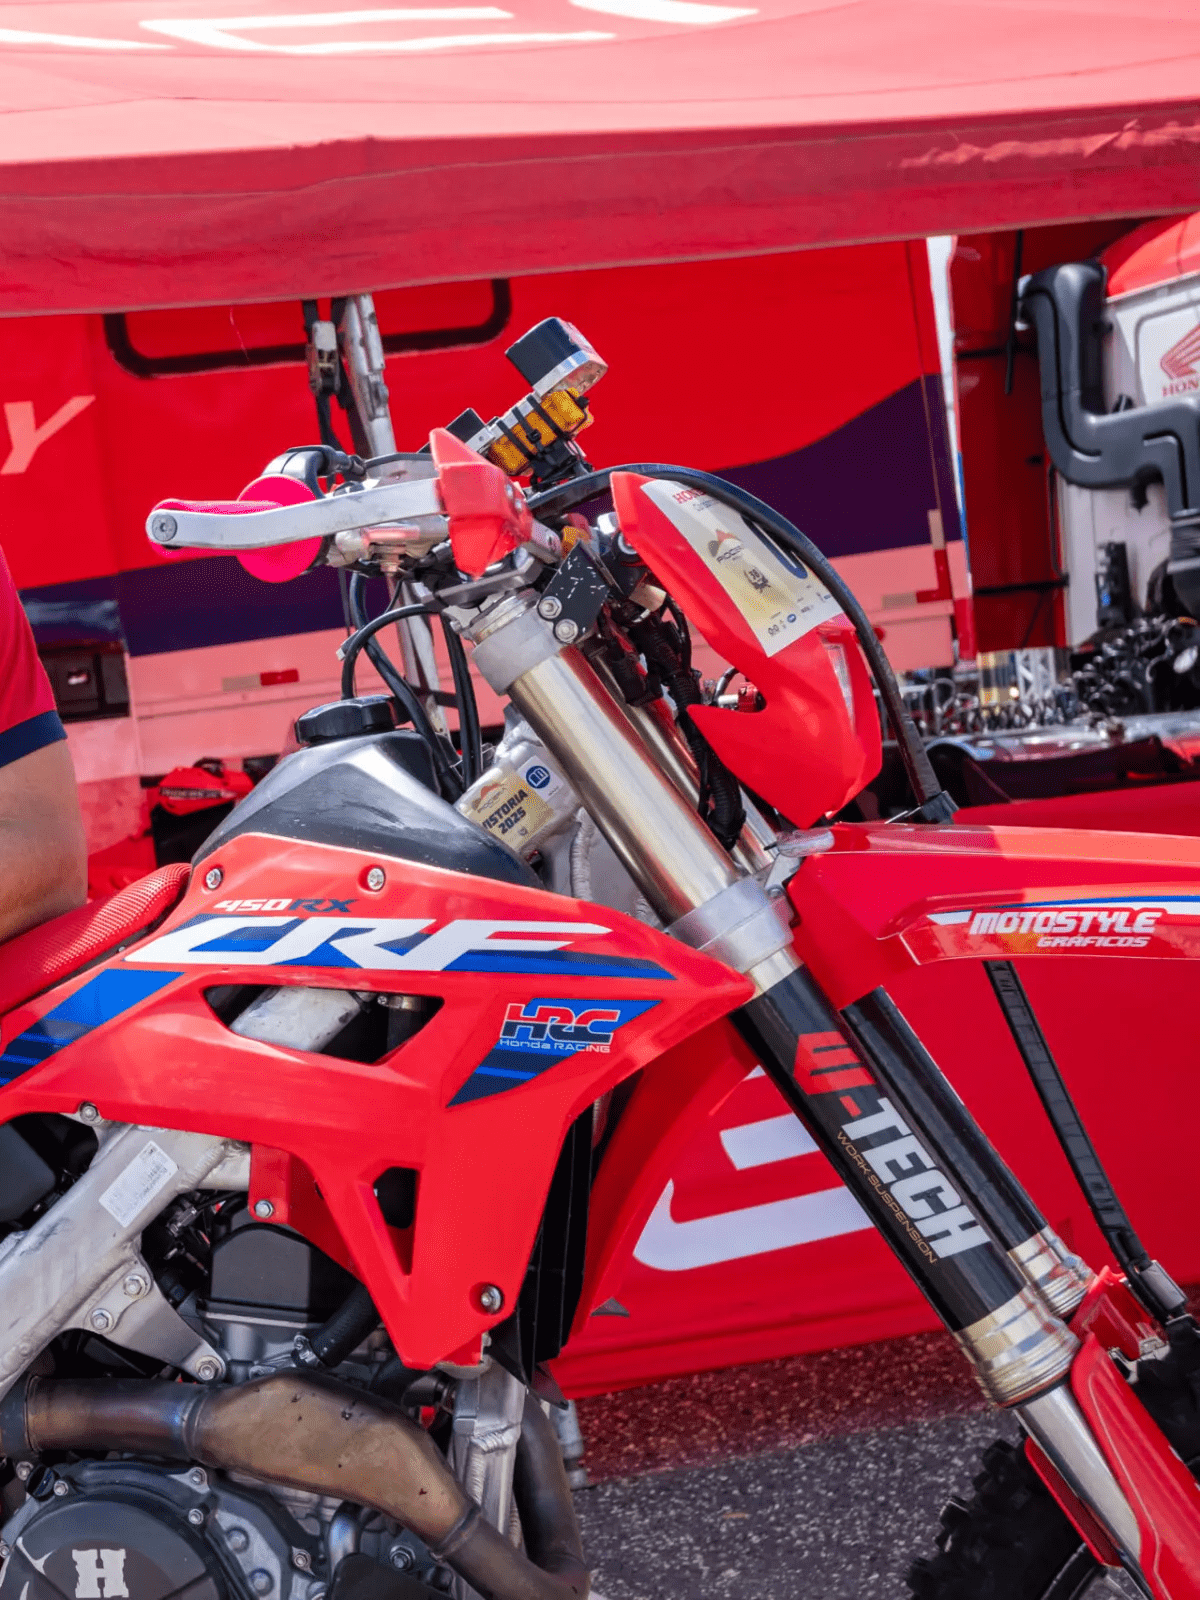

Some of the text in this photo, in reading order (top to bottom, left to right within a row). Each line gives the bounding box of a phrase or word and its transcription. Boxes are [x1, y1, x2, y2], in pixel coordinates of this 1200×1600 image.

[1162, 380, 1200, 397] HON
[498, 807, 526, 834] 2025
[213, 899, 358, 914] 450RX
[968, 911, 1163, 936] MOTOSTYLE
[124, 916, 613, 971] CRF
[500, 1003, 621, 1045] HRC
[500, 1039, 610, 1053] Honda RACING
[837, 1131, 938, 1264] WORK SUSPENSION
